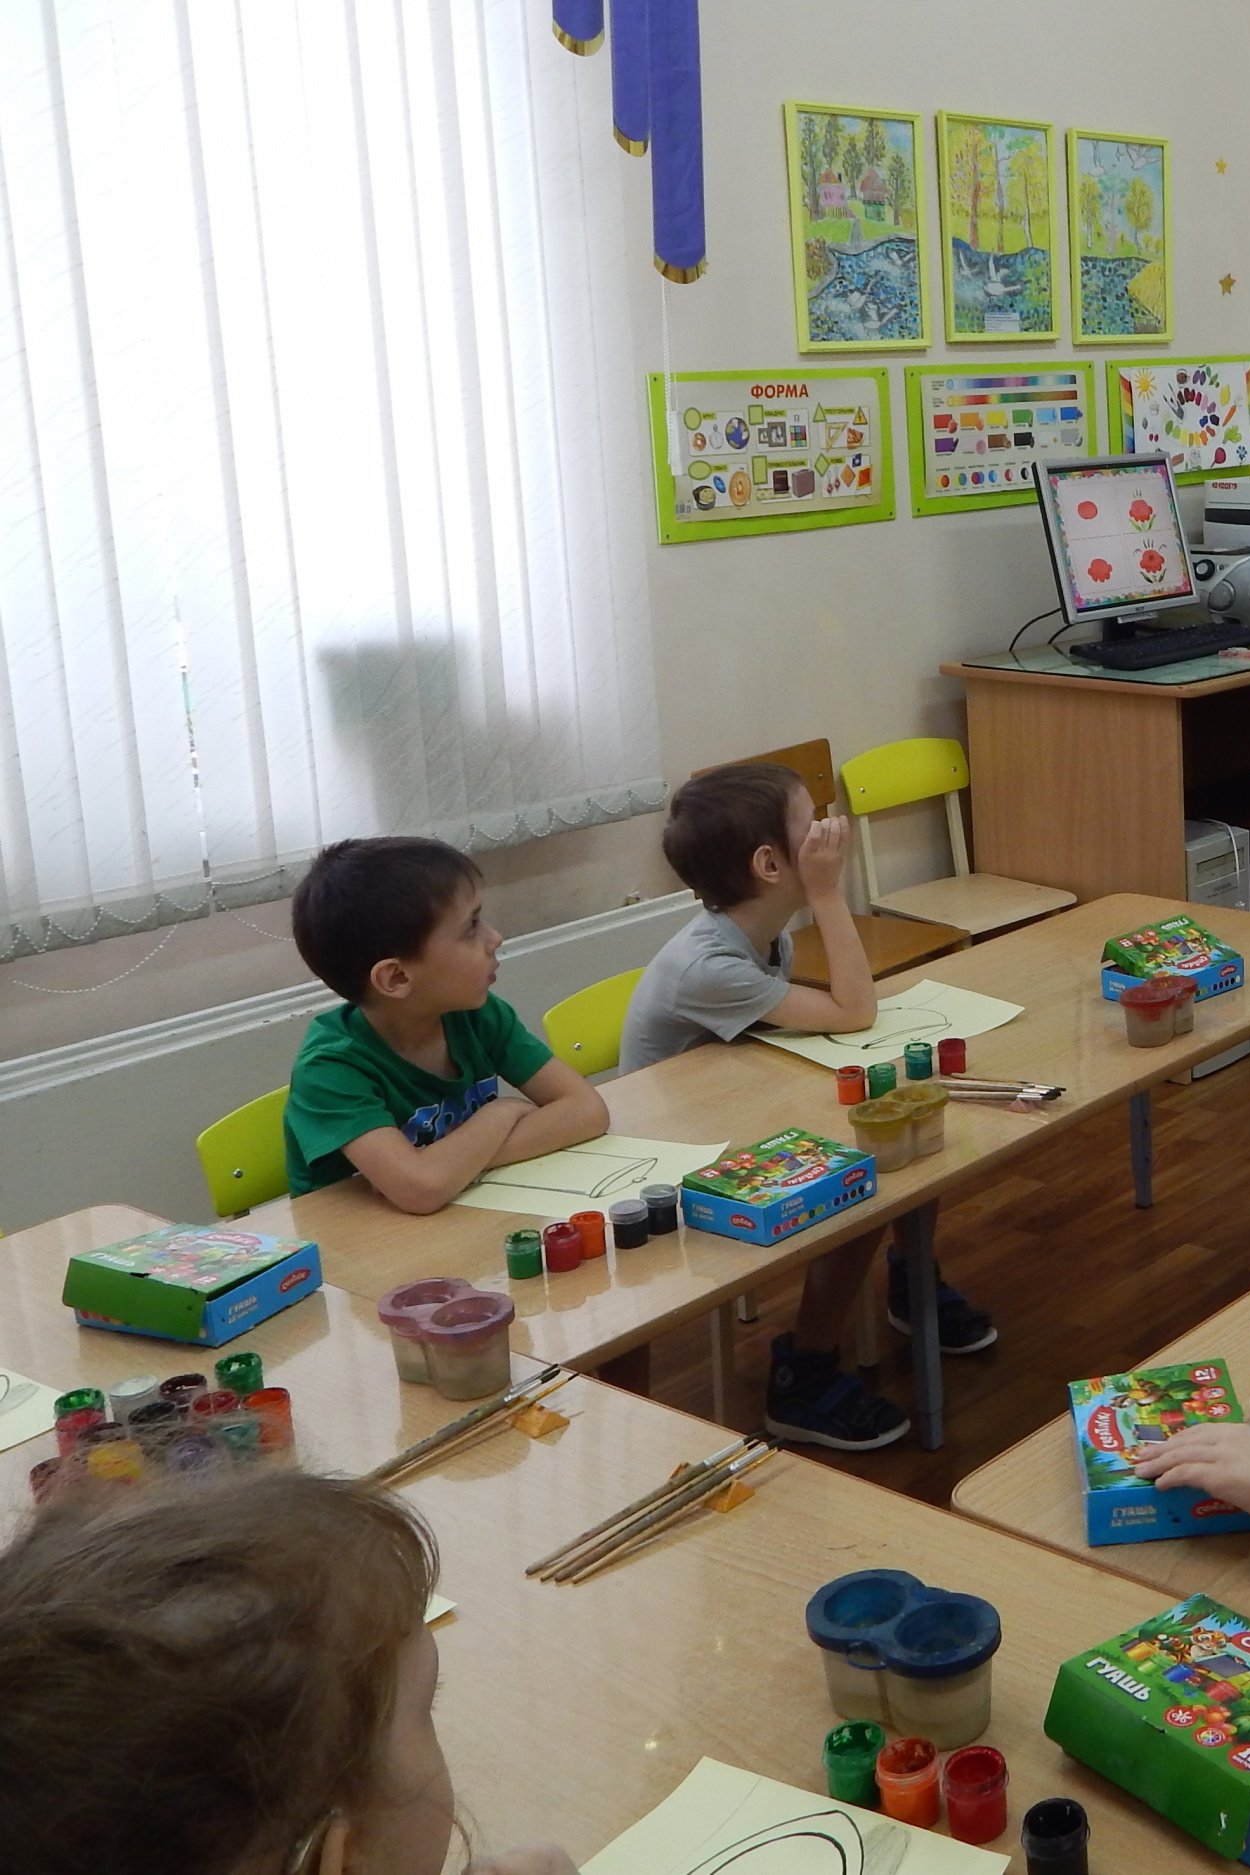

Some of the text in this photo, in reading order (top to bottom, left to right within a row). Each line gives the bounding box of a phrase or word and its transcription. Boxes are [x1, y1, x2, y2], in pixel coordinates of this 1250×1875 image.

[750, 383, 809, 399] ФОРМА
[759, 1131, 800, 1150] ГУАШЬ
[1195, 1370, 1209, 1382] 12
[1086, 1657, 1151, 1702] ГУАШЬ
